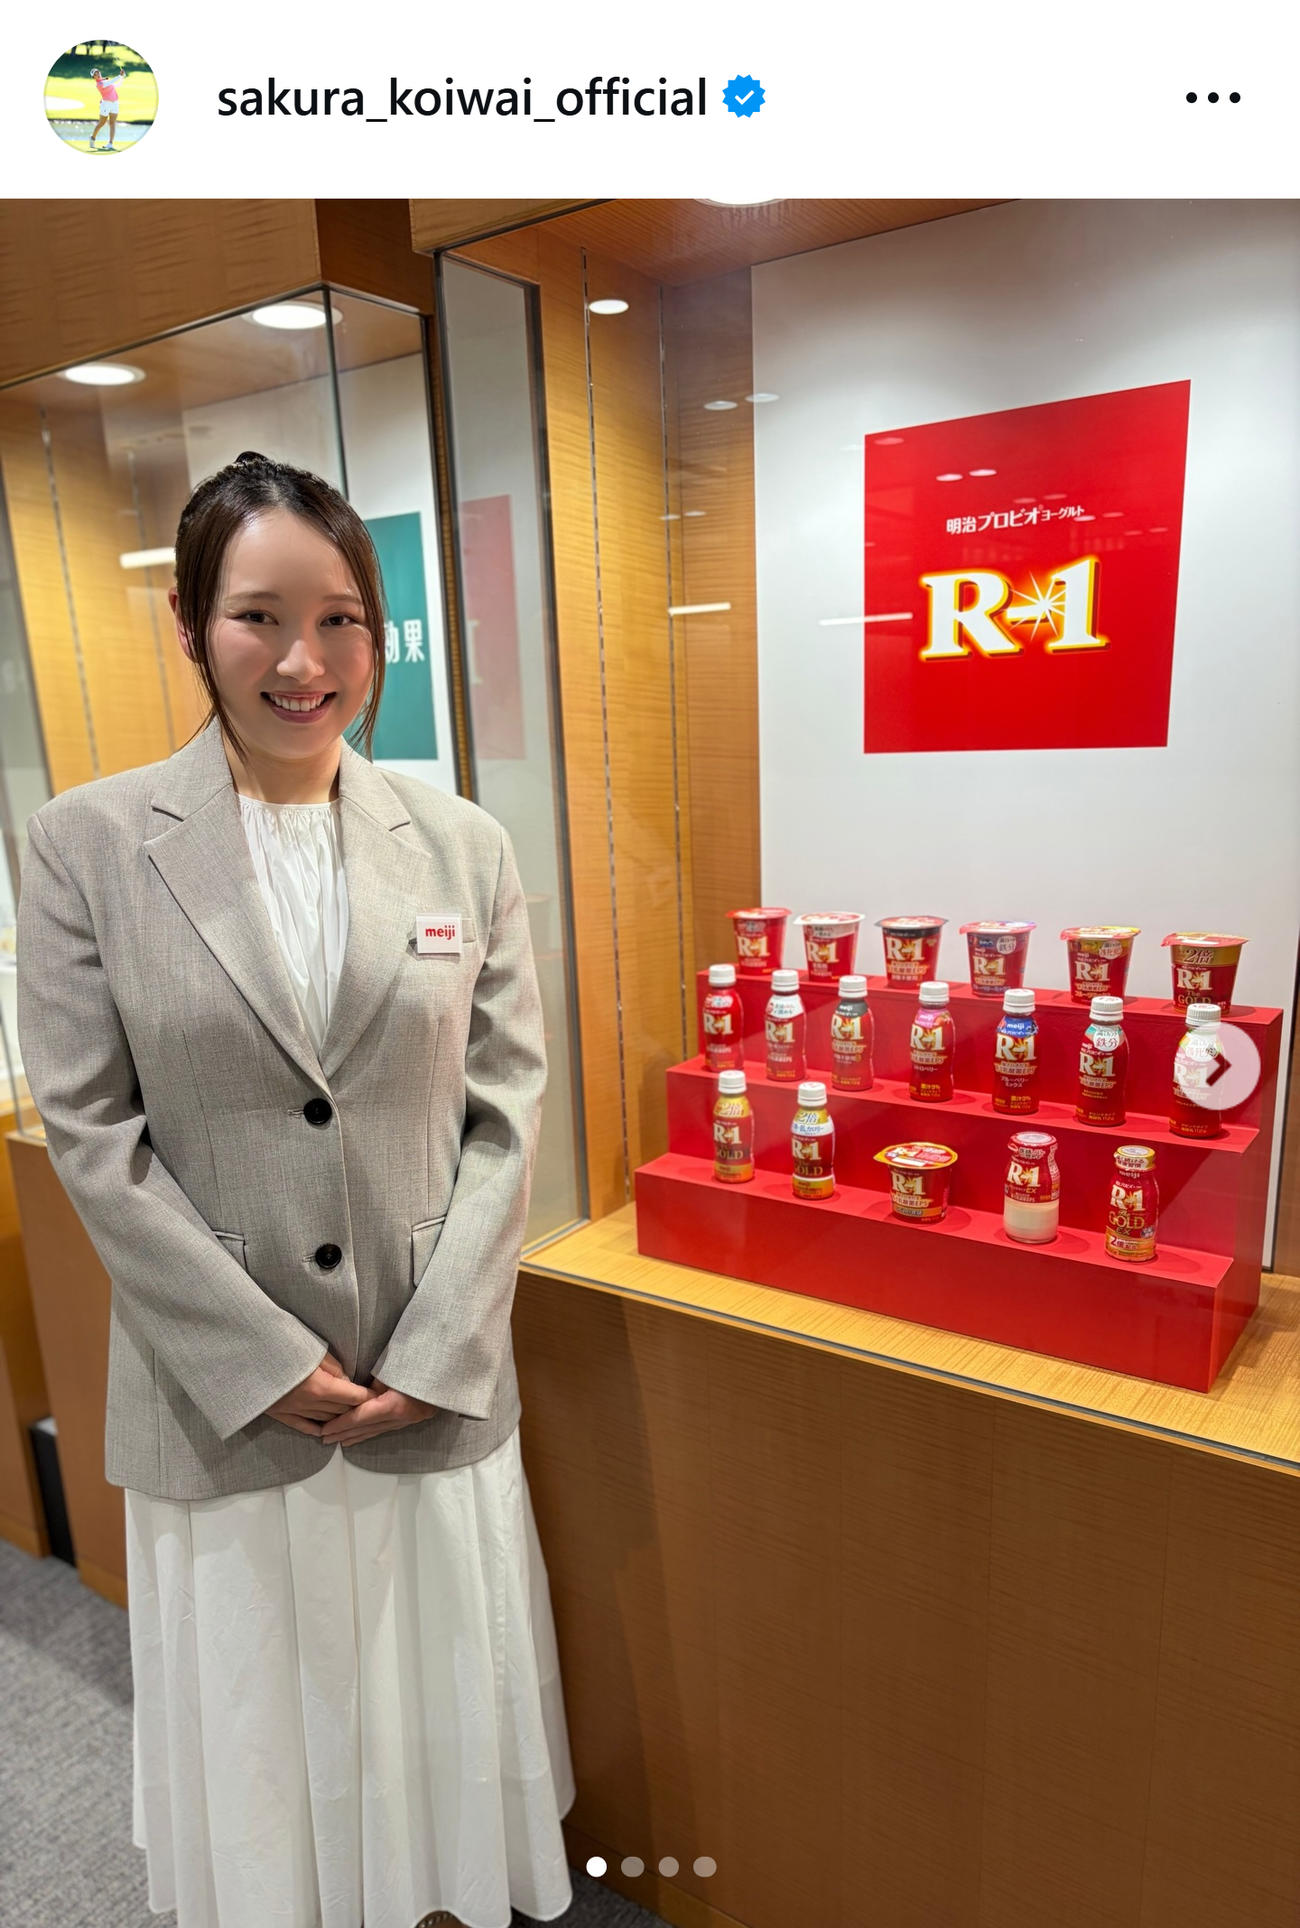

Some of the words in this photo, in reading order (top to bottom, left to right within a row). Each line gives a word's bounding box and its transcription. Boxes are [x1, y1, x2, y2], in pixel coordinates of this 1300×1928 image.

[920, 556, 1109, 660] R-1
[425, 924, 456, 941] meiji
[885, 937, 924, 960] R-1
[1075, 961, 1110, 981] R-1
[1176, 968, 1213, 990] R-1
[910, 1024, 946, 1050] R-1
[994, 1034, 1037, 1061] R-1
[1079, 1052, 1116, 1077] R-1
[891, 1170, 926, 1195] R-1
[1007, 1160, 1041, 1187] R-1
[1110, 1184, 1146, 1212] R-1
[1109, 1210, 1145, 1229] GOLD
